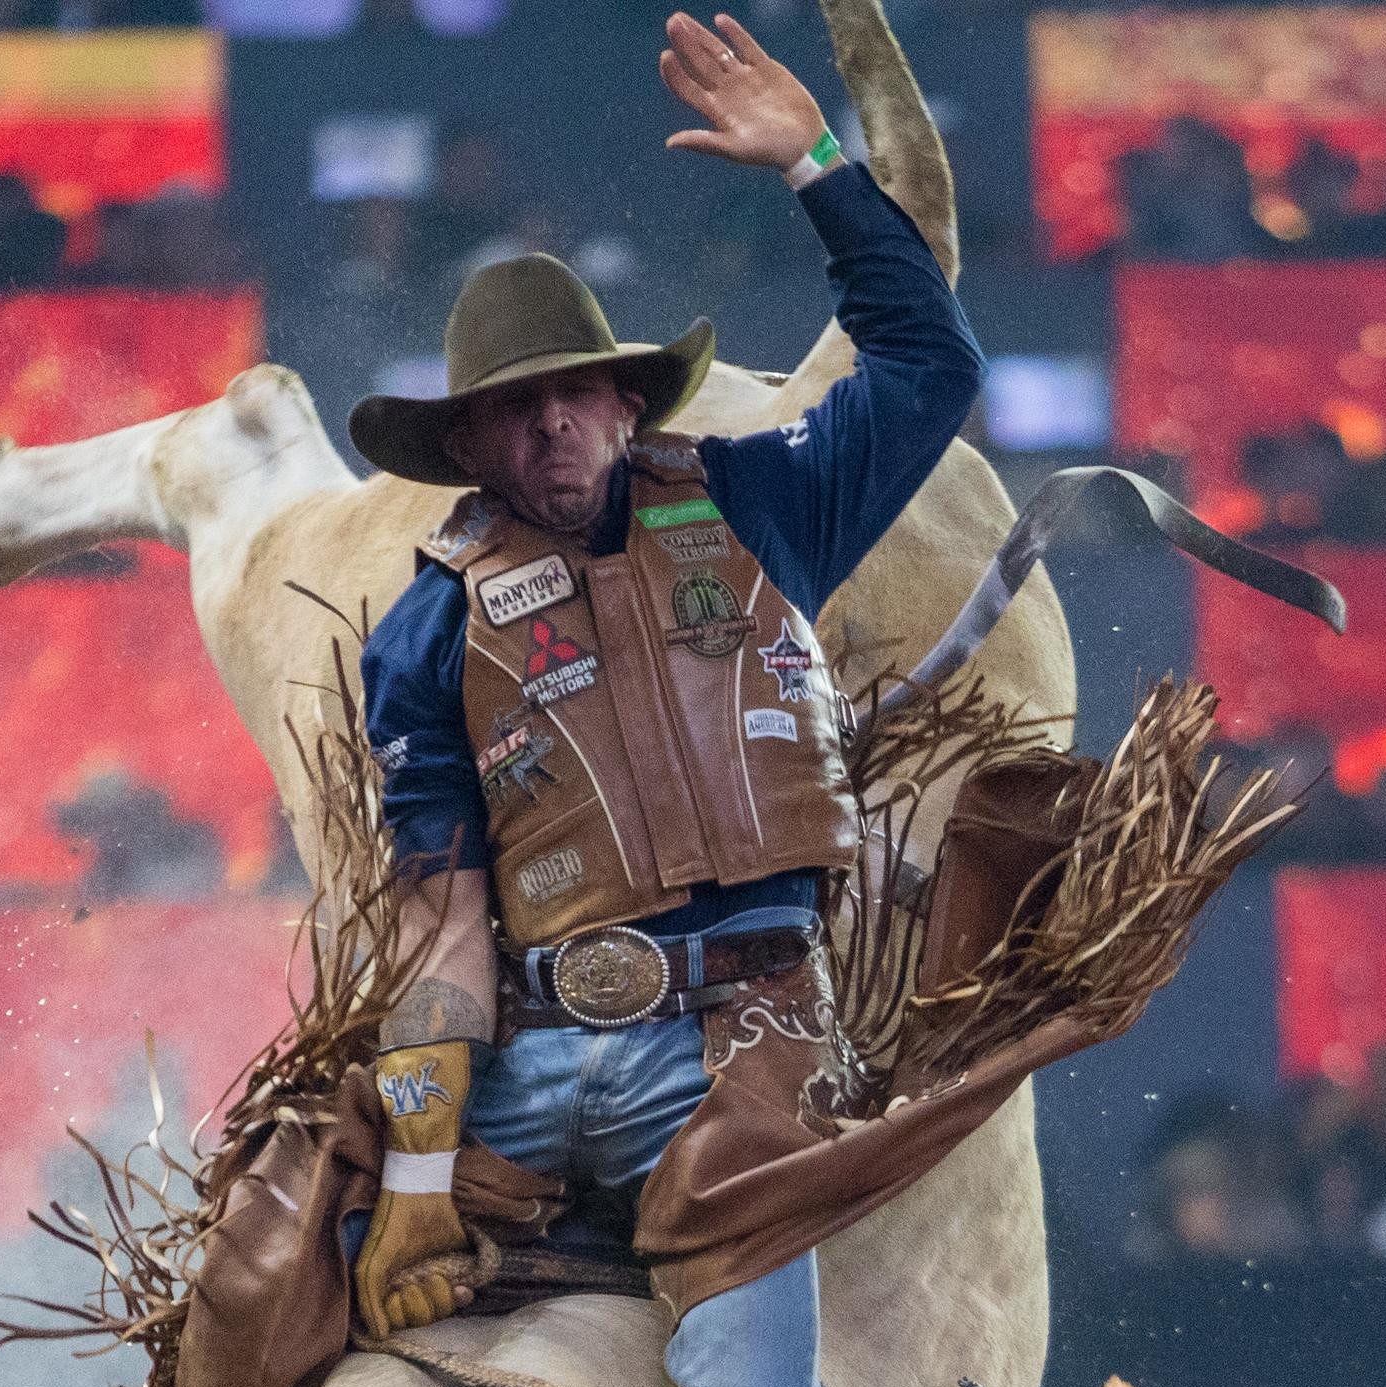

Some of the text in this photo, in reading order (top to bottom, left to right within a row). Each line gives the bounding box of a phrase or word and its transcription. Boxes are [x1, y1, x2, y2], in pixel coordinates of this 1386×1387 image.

[659, 524, 726, 549] COWBOY
[488, 584, 524, 611] MAN
[522, 655, 598, 698] MITSUBISHI
[536, 671, 595, 705] MOTORS
[519, 848, 583, 898] RODEIO
